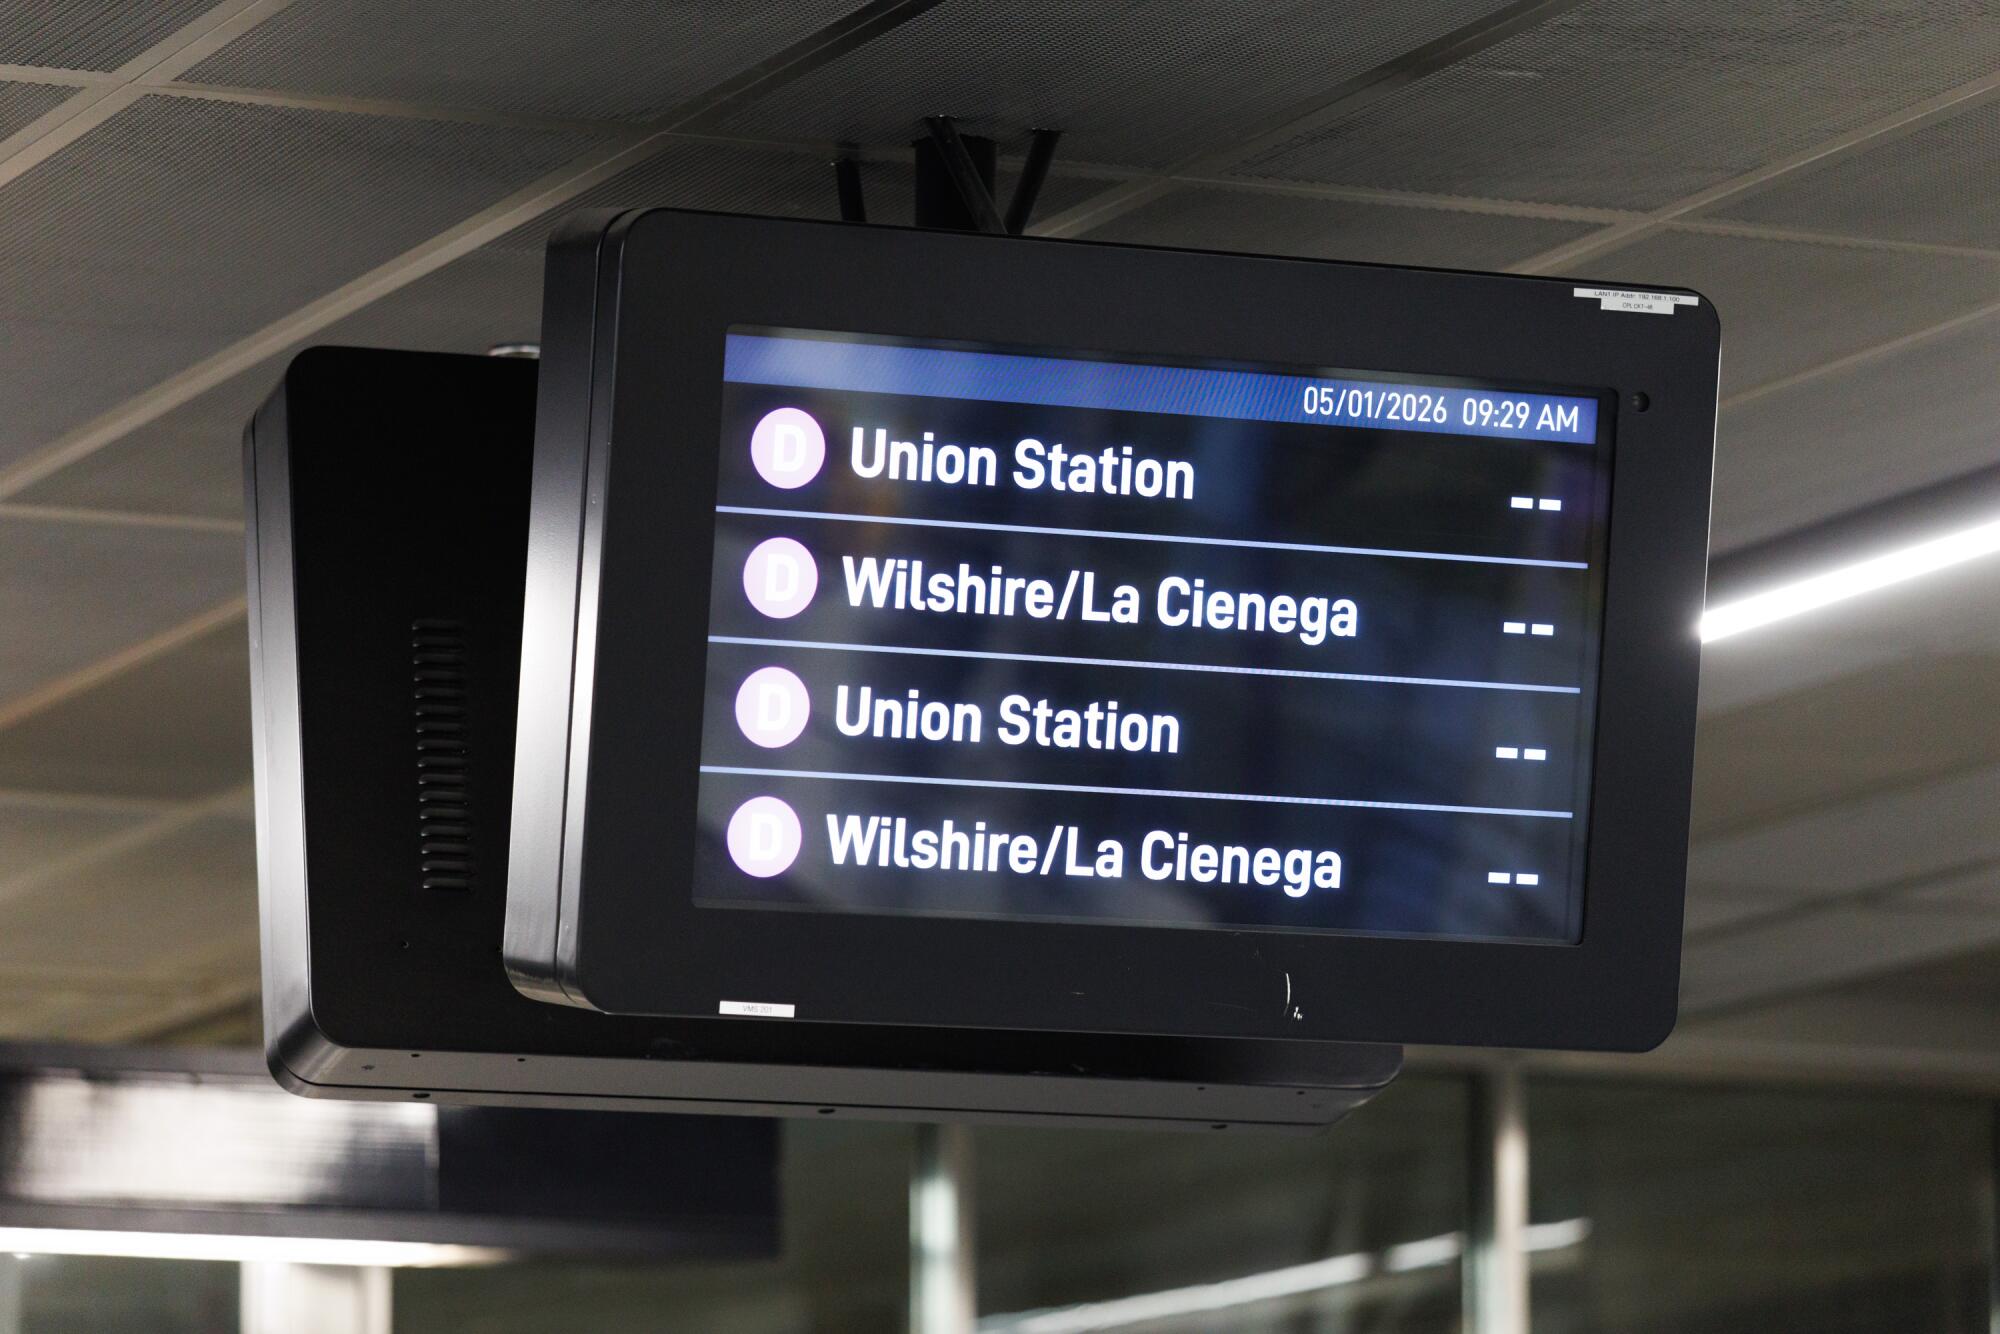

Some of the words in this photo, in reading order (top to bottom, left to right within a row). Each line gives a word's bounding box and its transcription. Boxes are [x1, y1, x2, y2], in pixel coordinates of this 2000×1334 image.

[1594, 290, 1611, 298] LAN1
[1303, 386, 1447, 424] 05/01/2026
[1462, 397, 1530, 429] 09:29
[1535, 403, 1579, 433] AM
[773, 424, 807, 472] D
[851, 426, 997, 486] Union
[1013, 438, 1194, 500] Station
[765, 553, 800, 602] D
[842, 555, 1140, 624] Wilshire/La
[1157, 576, 1358, 646] Cienega
[757, 683, 791, 731] D
[835, 684, 982, 743] Union
[997, 694, 1180, 753] Station
[749, 813, 784, 861] D
[826, 813, 1124, 878] Wilshire/La
[1140, 830, 1342, 898] Cienega
